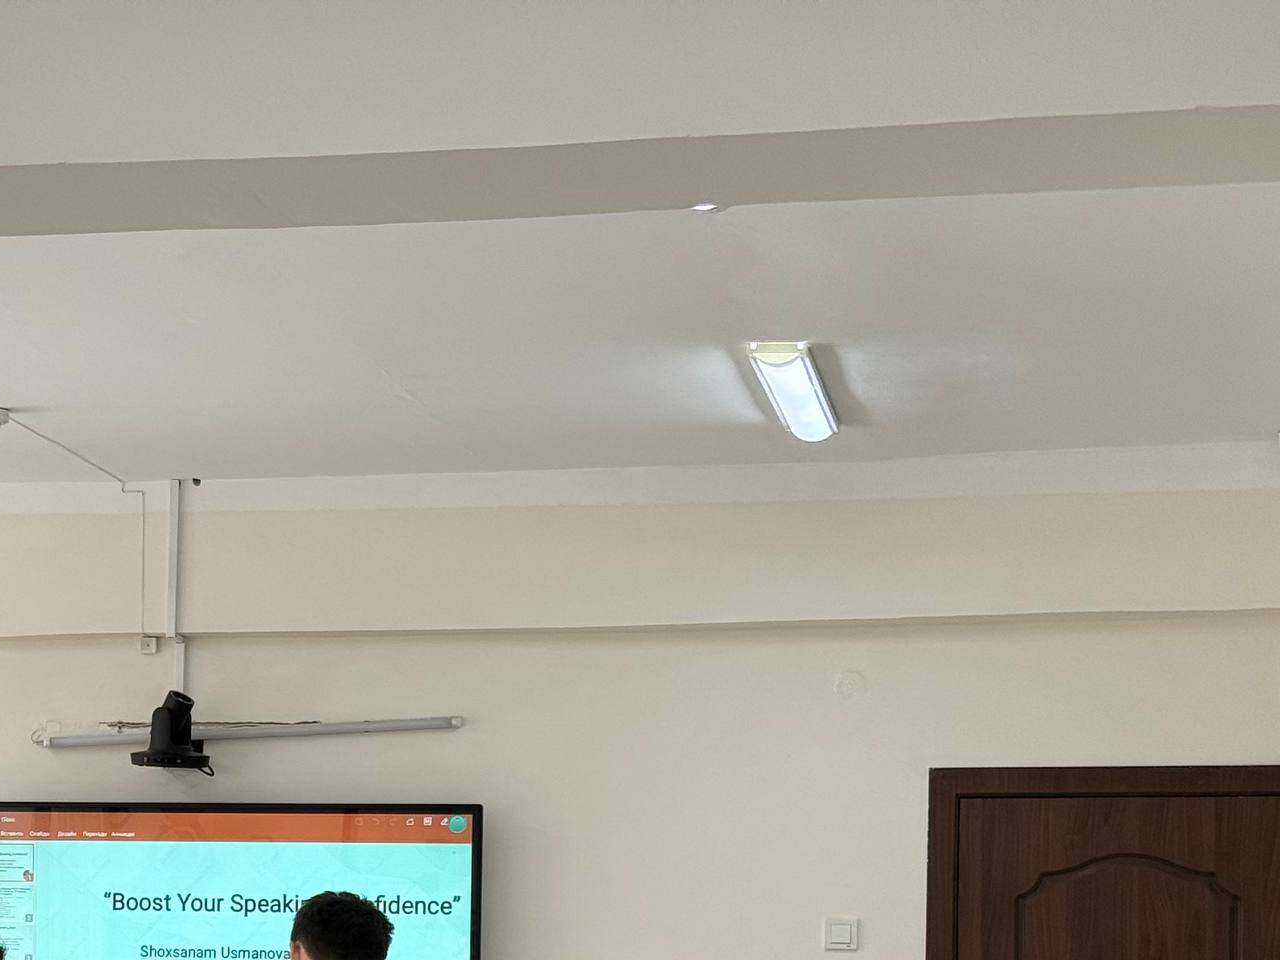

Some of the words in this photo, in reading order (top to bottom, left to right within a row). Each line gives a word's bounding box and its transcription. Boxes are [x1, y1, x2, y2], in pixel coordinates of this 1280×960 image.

[104, 891, 172, 912] “Boost
[177, 893, 224, 912] Your
[230, 894, 305, 917] Speaki
[373, 895, 461, 915] fidence”
[139, 944, 217, 959] Shoxsanam
[221, 945, 291, 960] Usmanova
